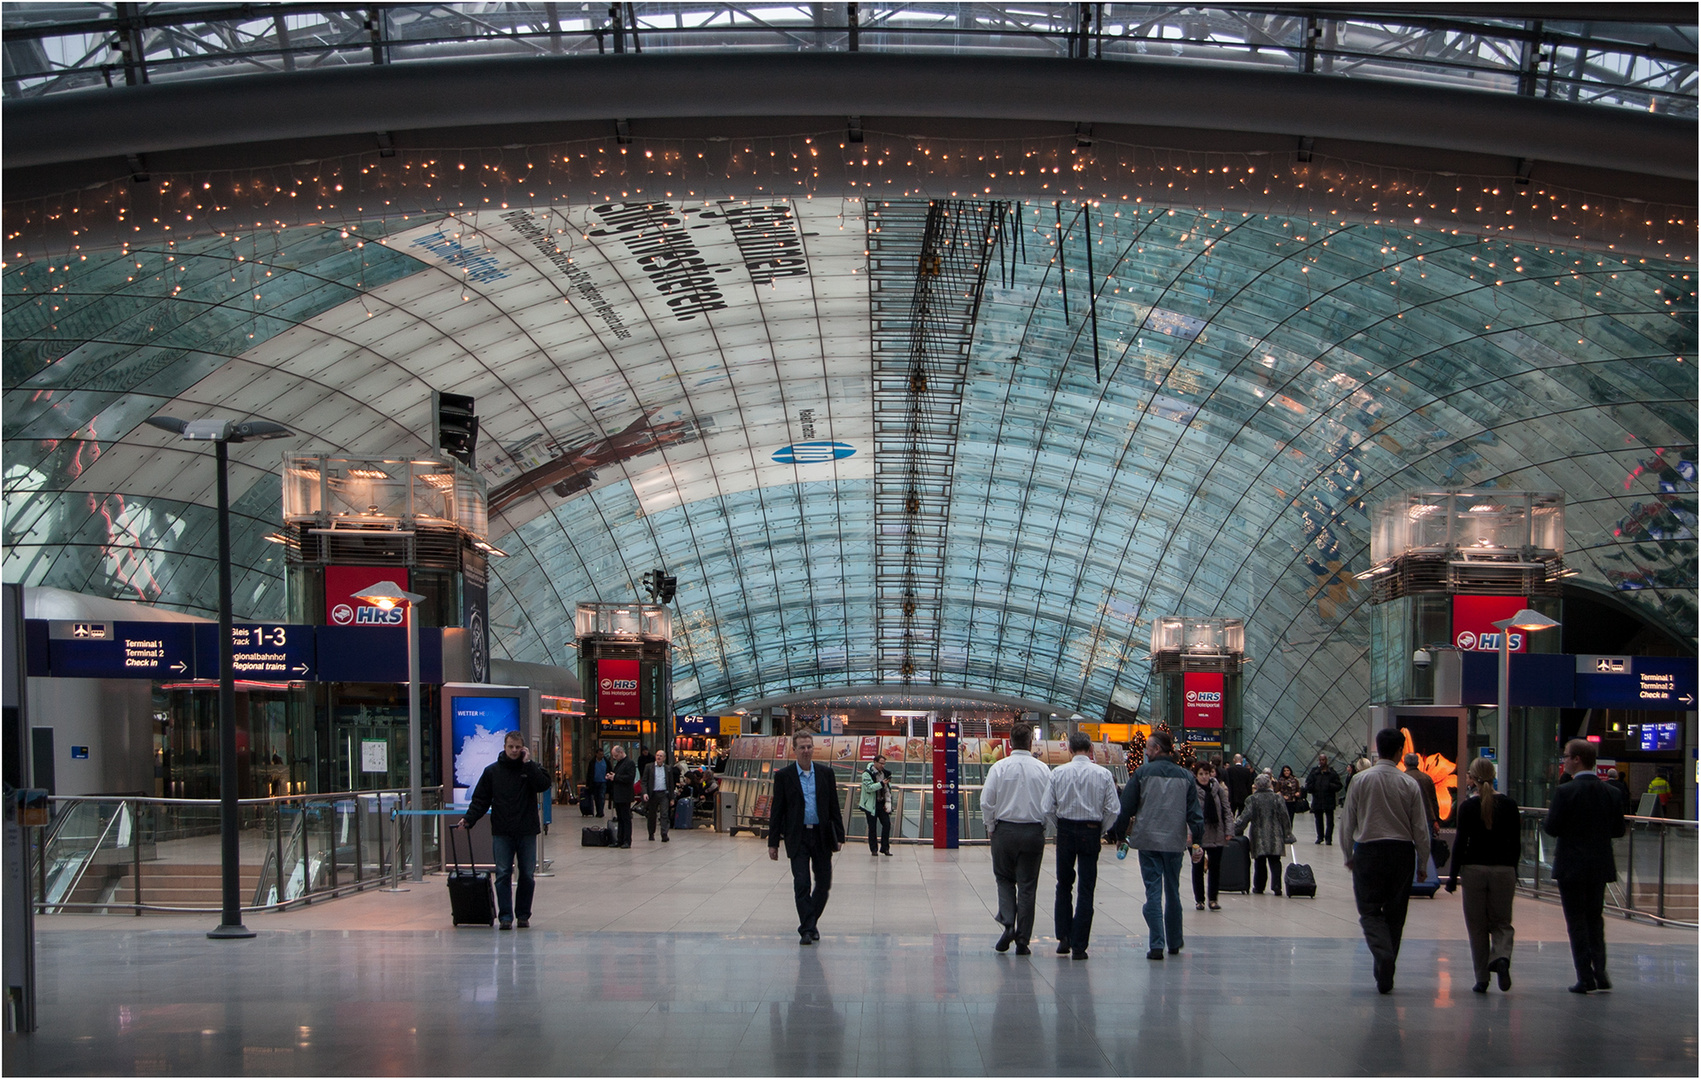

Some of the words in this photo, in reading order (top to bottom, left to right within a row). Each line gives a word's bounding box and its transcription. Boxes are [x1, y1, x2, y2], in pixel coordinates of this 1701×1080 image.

[356, 605, 404, 624] HRS
[253, 626, 287, 647] 1-3
[125, 639, 157, 648] Terminal
[158, 640, 163, 648] 1
[125, 649, 157, 657] Terminal
[158, 649, 165, 657] 2
[125, 658, 149, 667] Check
[150, 659, 158, 667] in
[265, 662, 287, 671] trains
[1639, 673, 1668, 681] Terminal
[612, 679, 638, 690] HRS
[1639, 682, 1668, 690] Terminal
[1196, 691, 1221, 702] HRS
[1639, 691, 1660, 699] Check
[1661, 691, 1669, 699] in
[684, 715, 696, 723] 6-7
